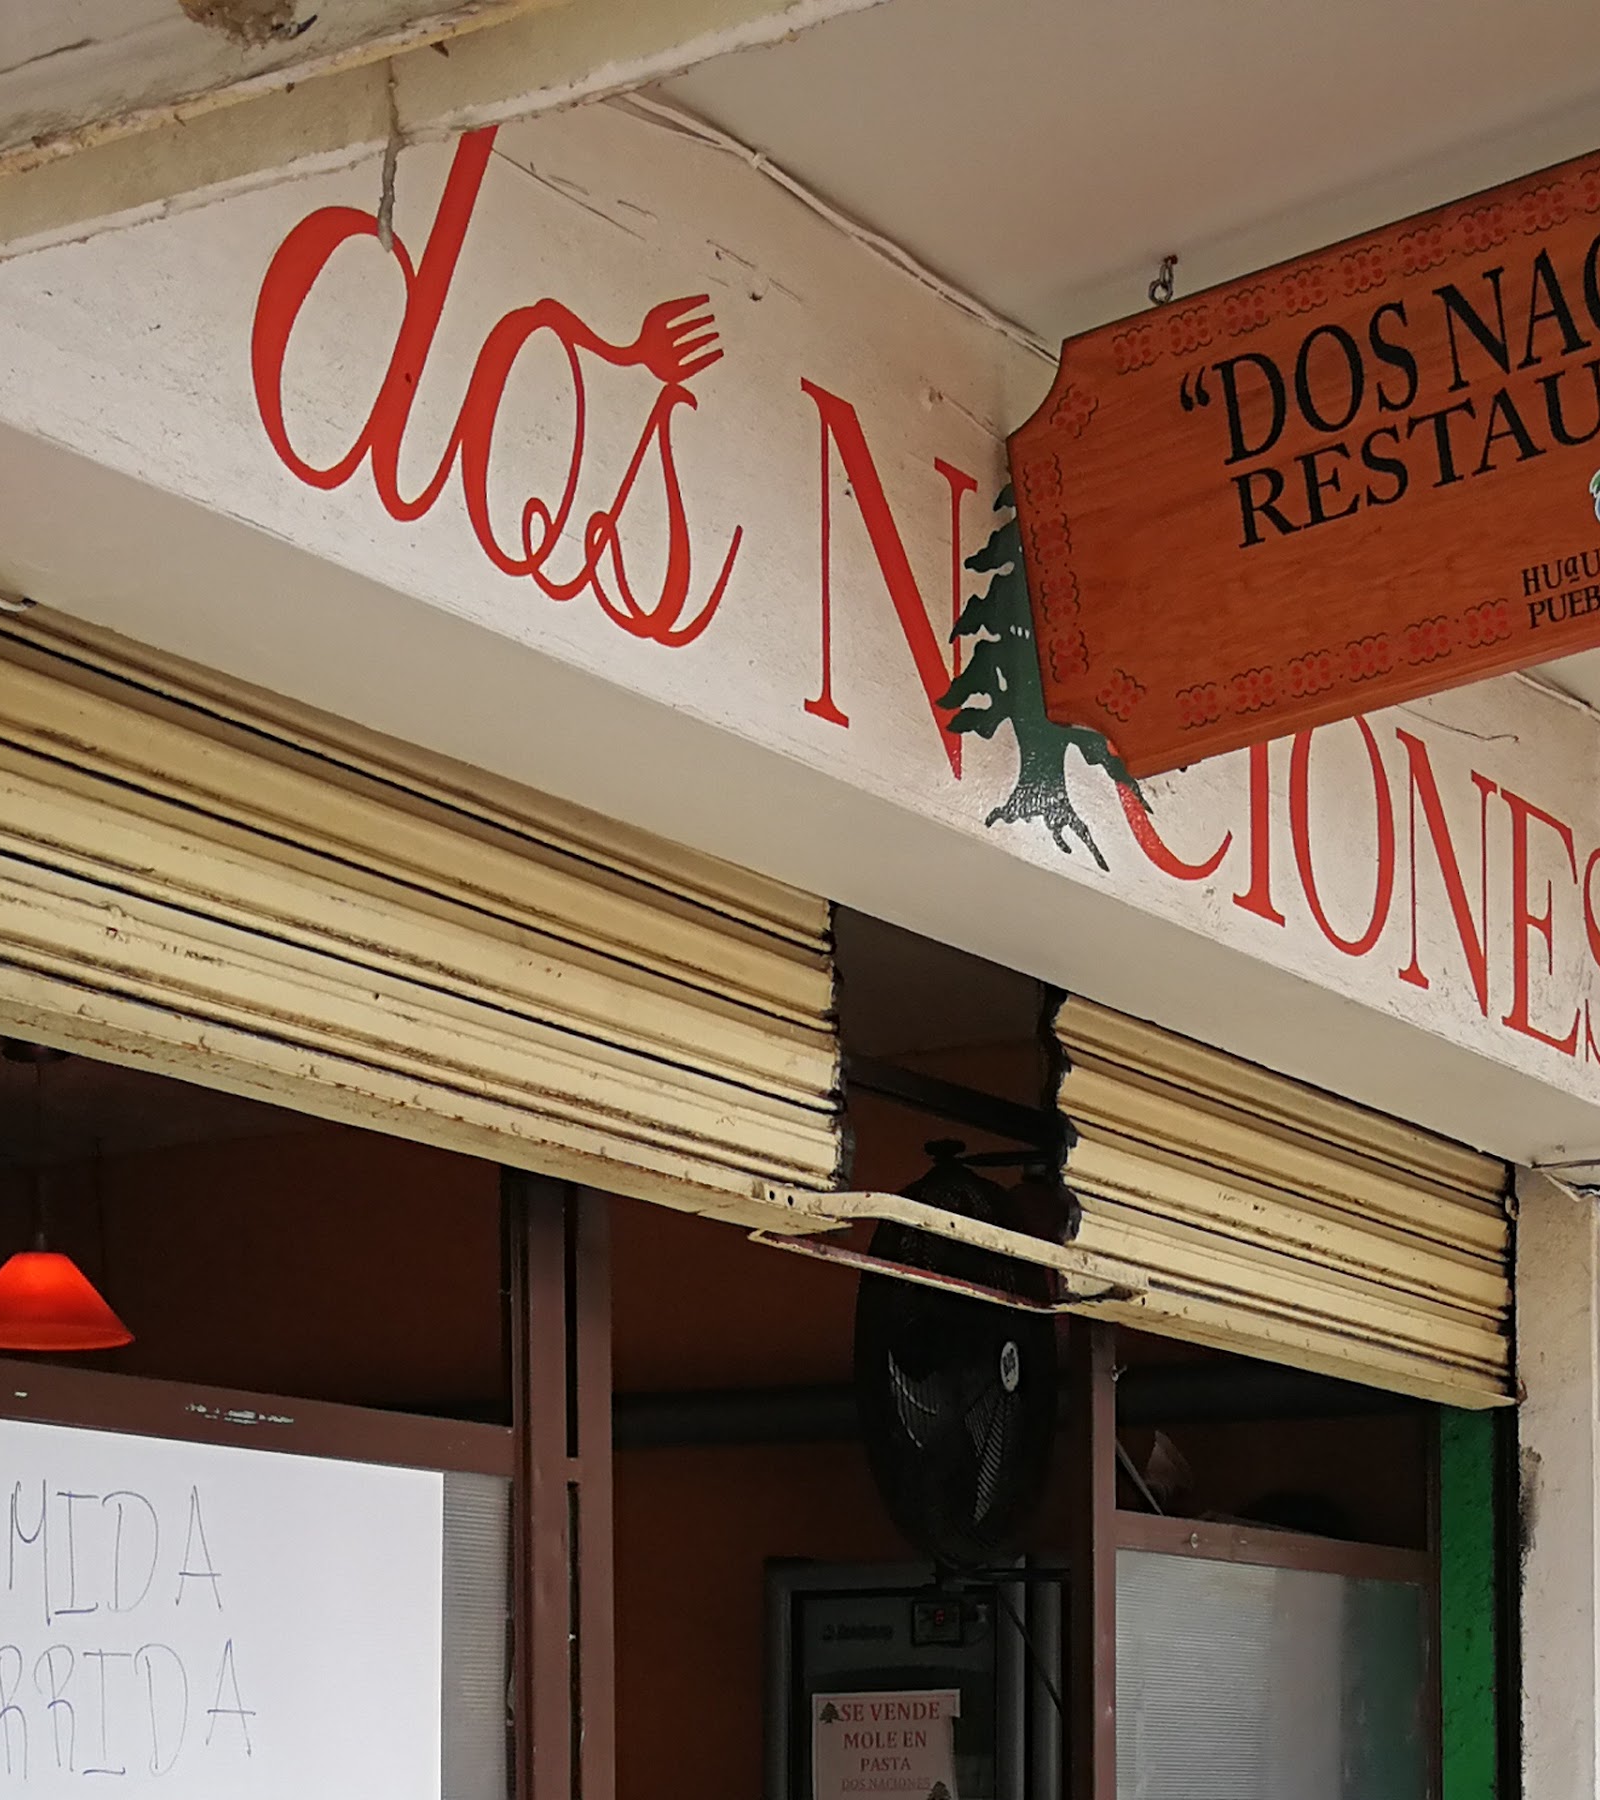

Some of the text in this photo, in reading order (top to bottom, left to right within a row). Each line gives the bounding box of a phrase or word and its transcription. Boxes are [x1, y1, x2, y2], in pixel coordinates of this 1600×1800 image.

[251, 125, 744, 648] dos
[841, 1701, 941, 1722] SE VENDE
[843, 1730, 927, 1750] MOLE EN
[860, 1756, 912, 1772] PASTA
